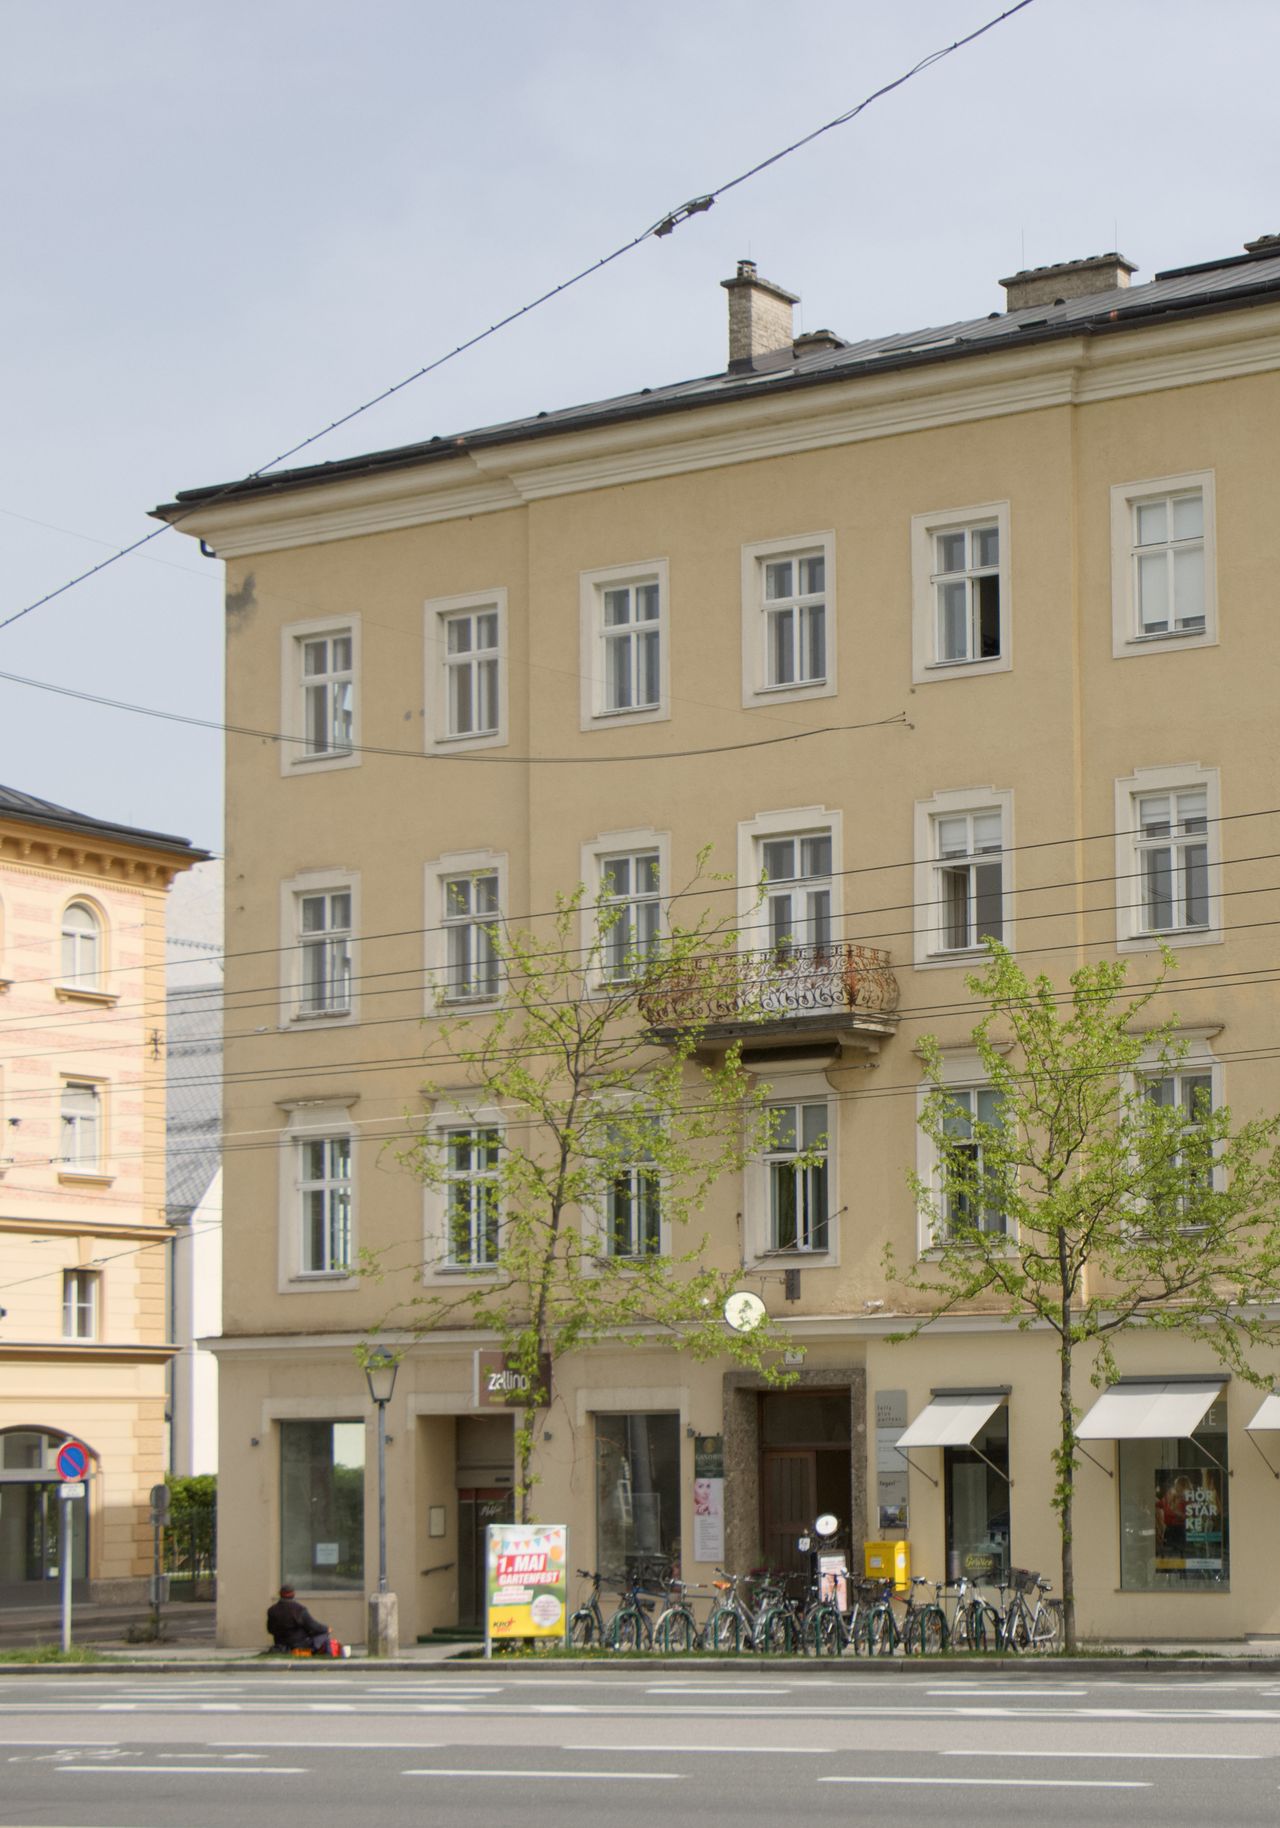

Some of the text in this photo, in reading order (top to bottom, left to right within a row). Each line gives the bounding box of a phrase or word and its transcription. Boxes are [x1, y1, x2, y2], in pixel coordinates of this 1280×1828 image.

[1185, 1487, 1215, 1501] HÖR
[1185, 1502, 1217, 1516] STÄR
[1185, 1518, 1202, 1531] KE
[499, 1572, 558, 1585] GARTENFEST
